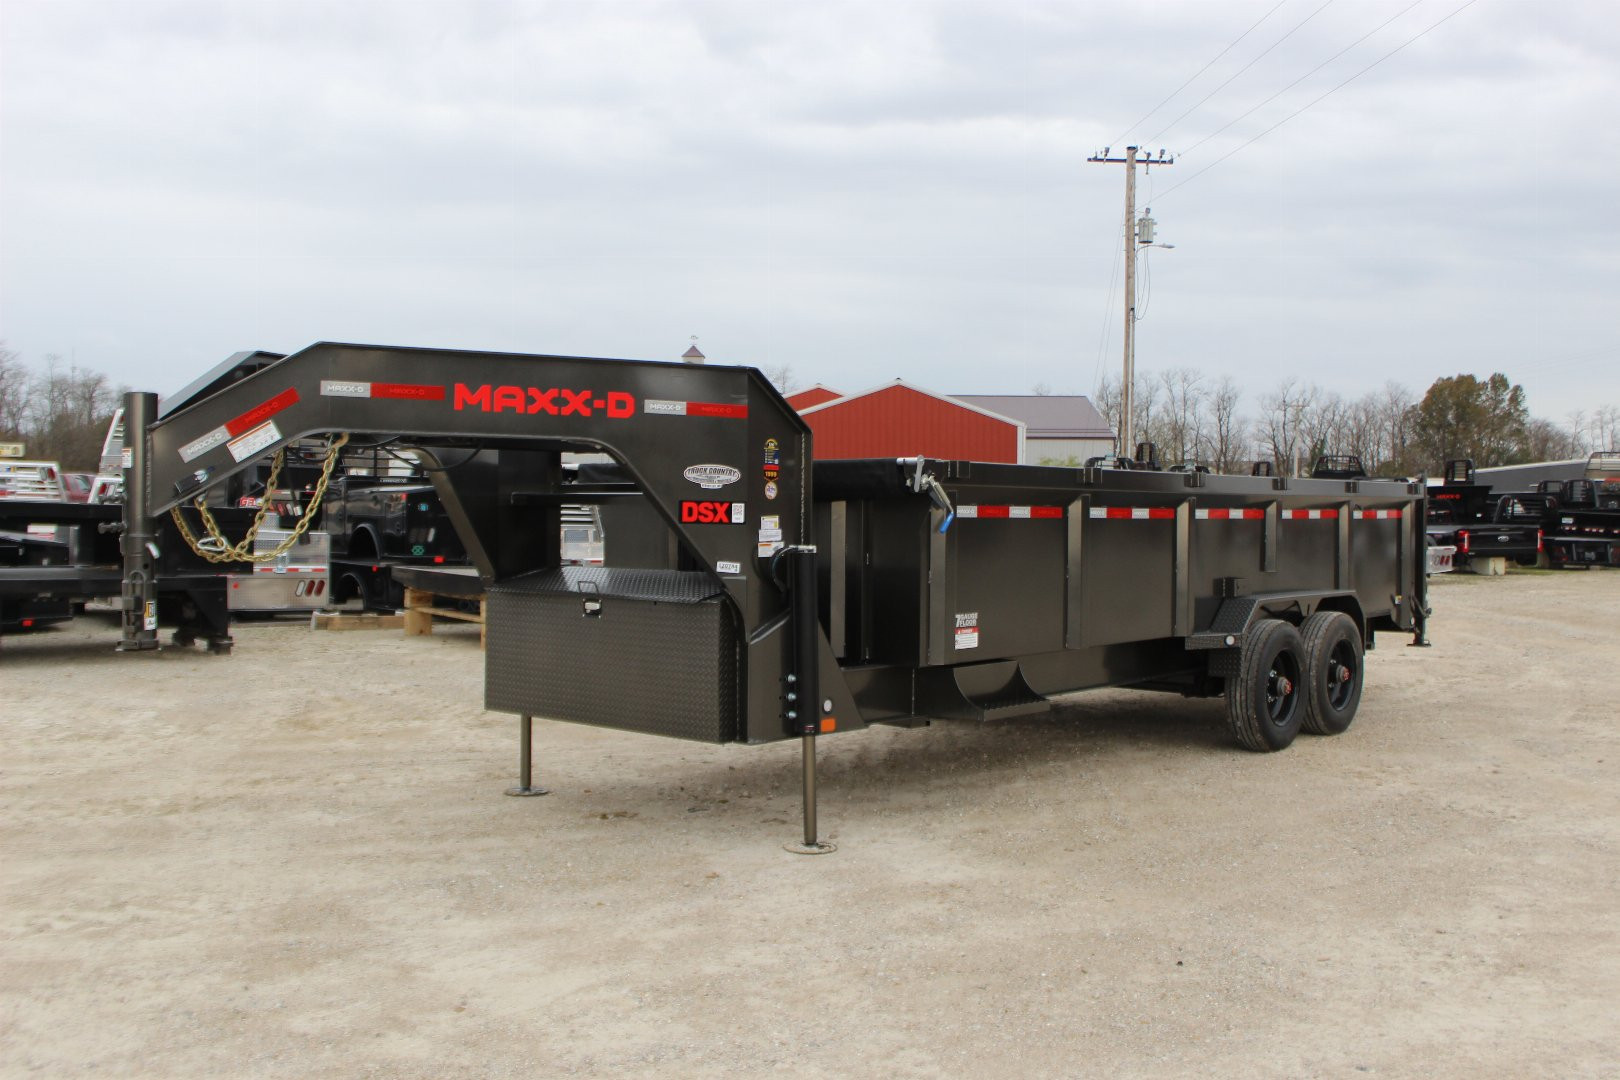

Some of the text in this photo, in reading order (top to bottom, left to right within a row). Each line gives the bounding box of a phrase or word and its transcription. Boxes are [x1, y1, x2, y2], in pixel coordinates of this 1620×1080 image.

[327, 384, 364, 393] MAXX-D
[454, 382, 635, 419] MAXX-D
[650, 403, 682, 411] MAXX-D
[187, 432, 222, 456] MAXX-D
[687, 467, 738, 477] TRUCK COUNTRY
[681, 501, 730, 523] DSX
[960, 619, 977, 627] FLOOR
